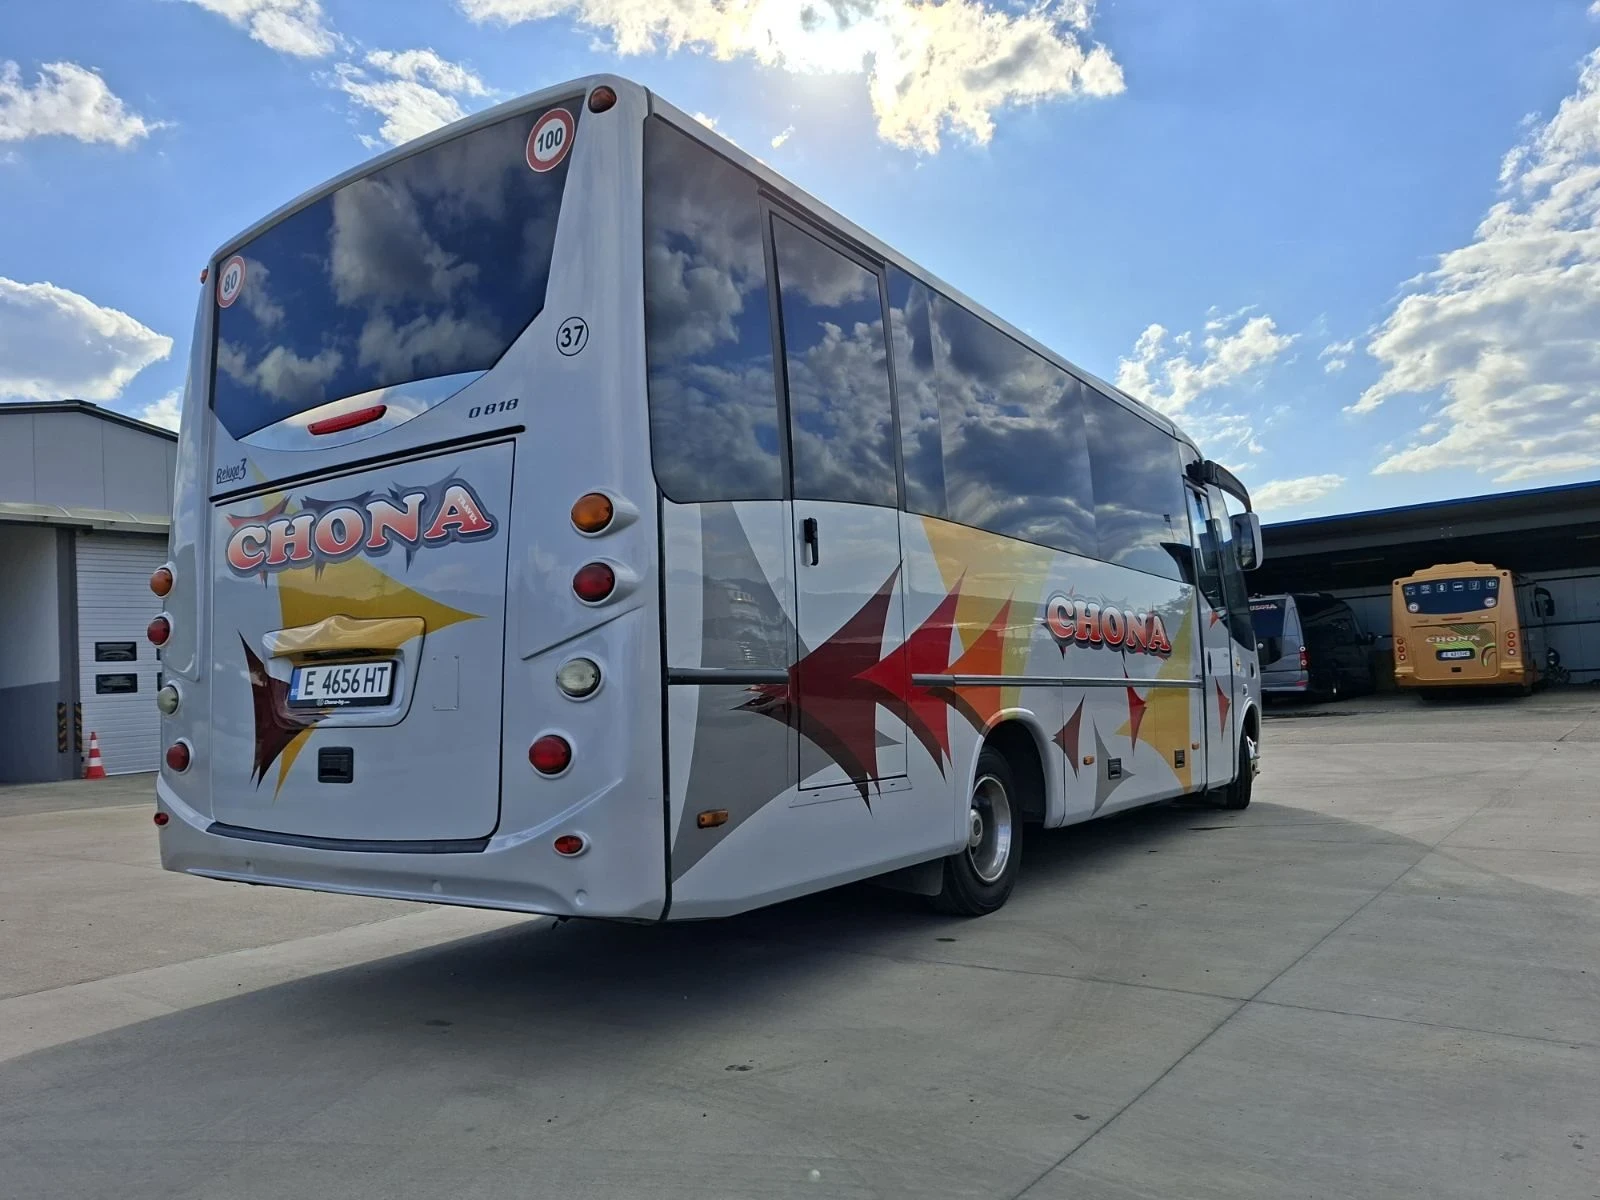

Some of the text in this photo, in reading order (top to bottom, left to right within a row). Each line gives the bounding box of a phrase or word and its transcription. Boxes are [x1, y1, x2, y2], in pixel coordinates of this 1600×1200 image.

[537, 127, 563, 152] 100
[224, 270, 238, 292] 80
[560, 324, 585, 348] 37
[484, 398, 519, 416] 818
[457, 494, 478, 525] TRAVEL
[227, 485, 492, 570] CHONA
[1047, 596, 1171, 651] CHONA
[1425, 635, 1480, 643] CHONA
[304, 666, 389, 696] E 4656 HT
